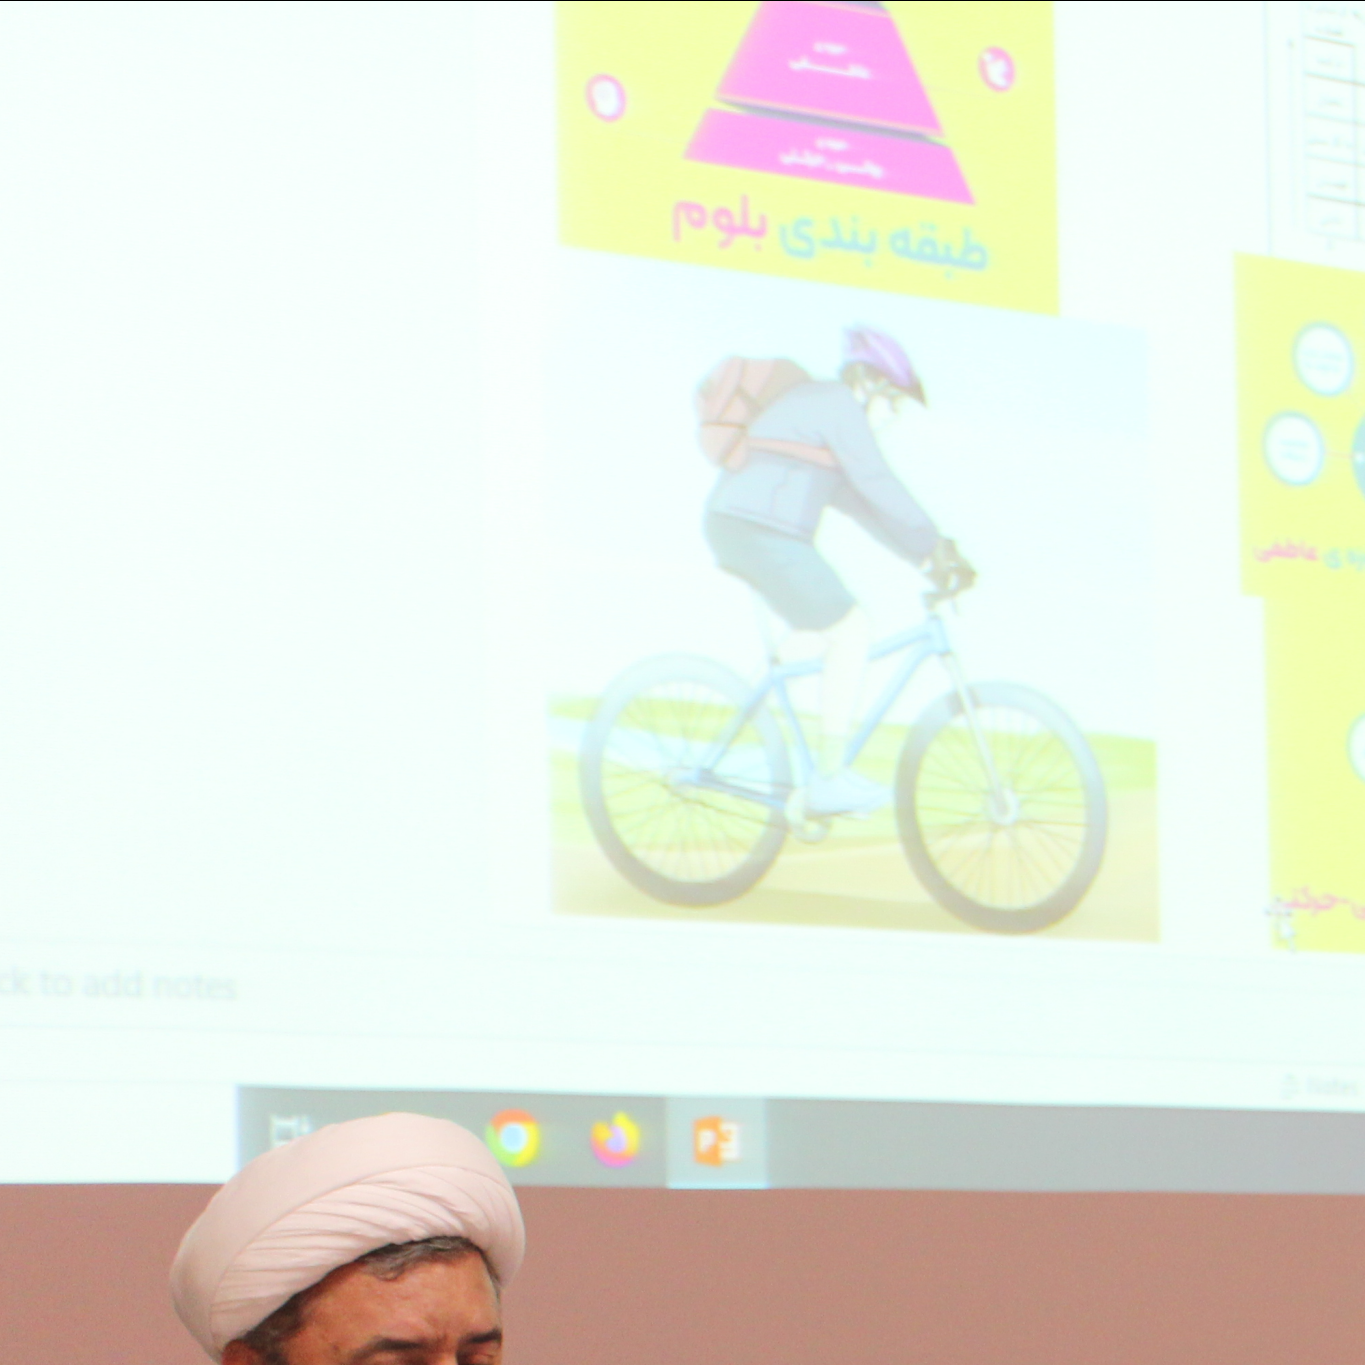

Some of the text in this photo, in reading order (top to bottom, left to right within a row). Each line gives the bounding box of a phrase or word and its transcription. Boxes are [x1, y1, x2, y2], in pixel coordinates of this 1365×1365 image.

[673, 194, 988, 280] طبقه بندی بلوم
[38, 968, 74, 998] to
[82, 968, 144, 999] add
[152, 972, 238, 1001] notes
